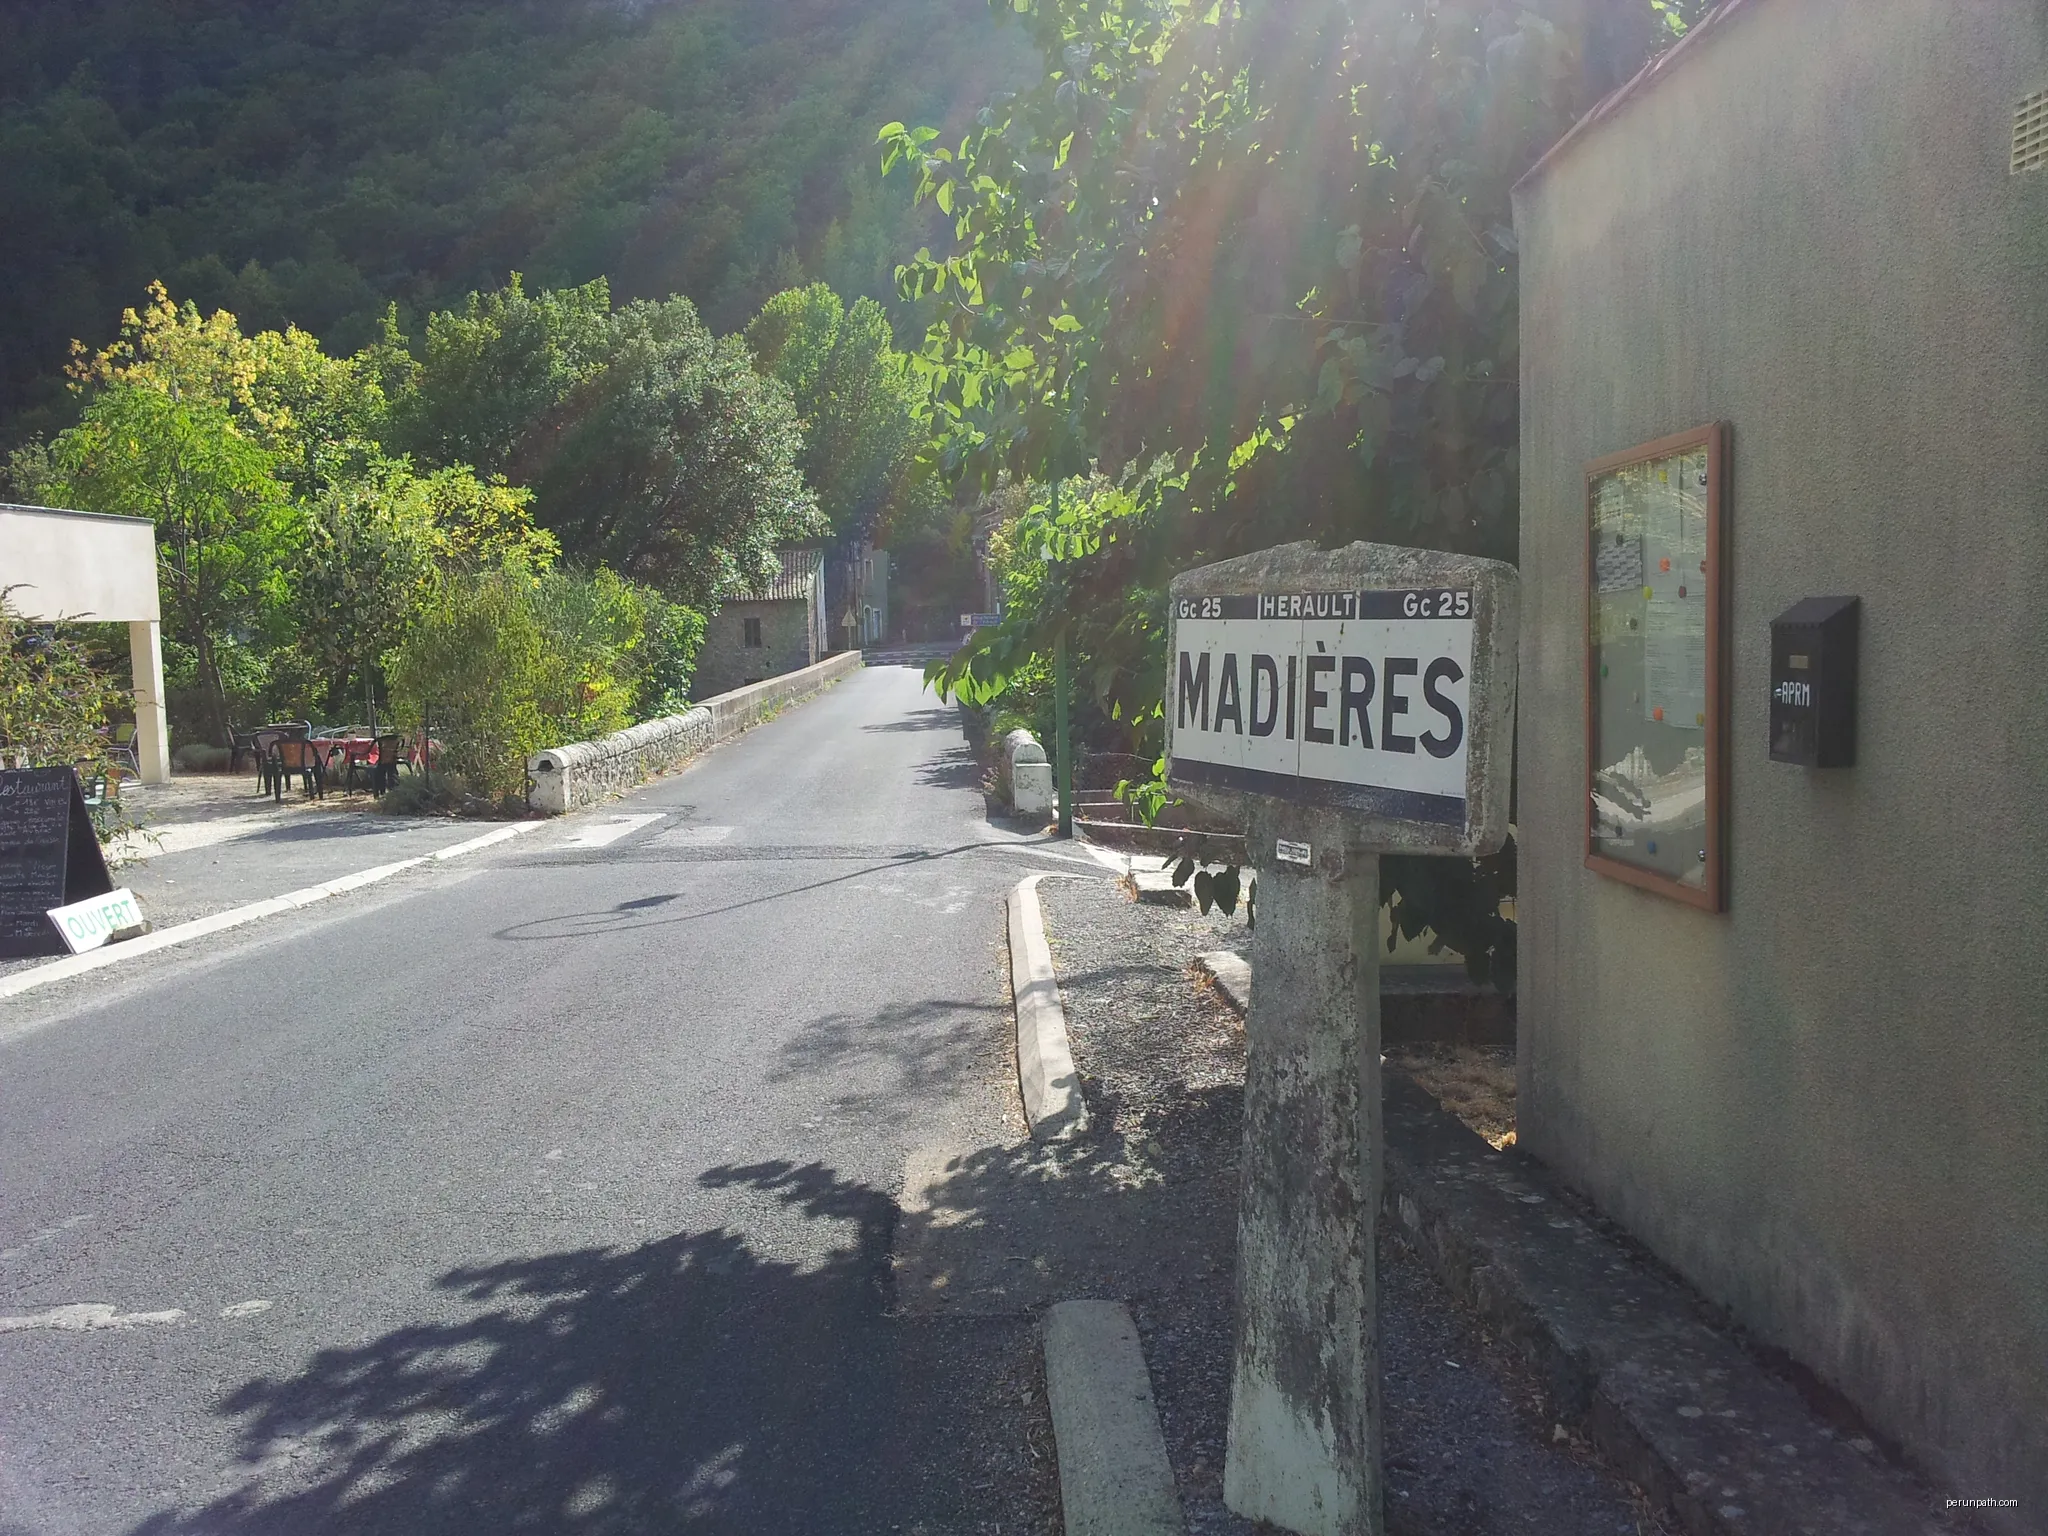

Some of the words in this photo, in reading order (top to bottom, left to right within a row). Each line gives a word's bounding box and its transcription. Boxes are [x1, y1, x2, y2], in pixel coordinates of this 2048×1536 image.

[1179, 600, 1196, 617] Gc
[1202, 598, 1221, 617] 25
[1264, 594, 1352, 617] HERAULT
[1403, 593, 1431, 617] Gc
[1438, 592, 1469, 616] 25
[1178, 641, 1464, 759] MADIÈRES
[1782, 681, 1810, 707] APRM
[67, 900, 135, 939] OUVERT
